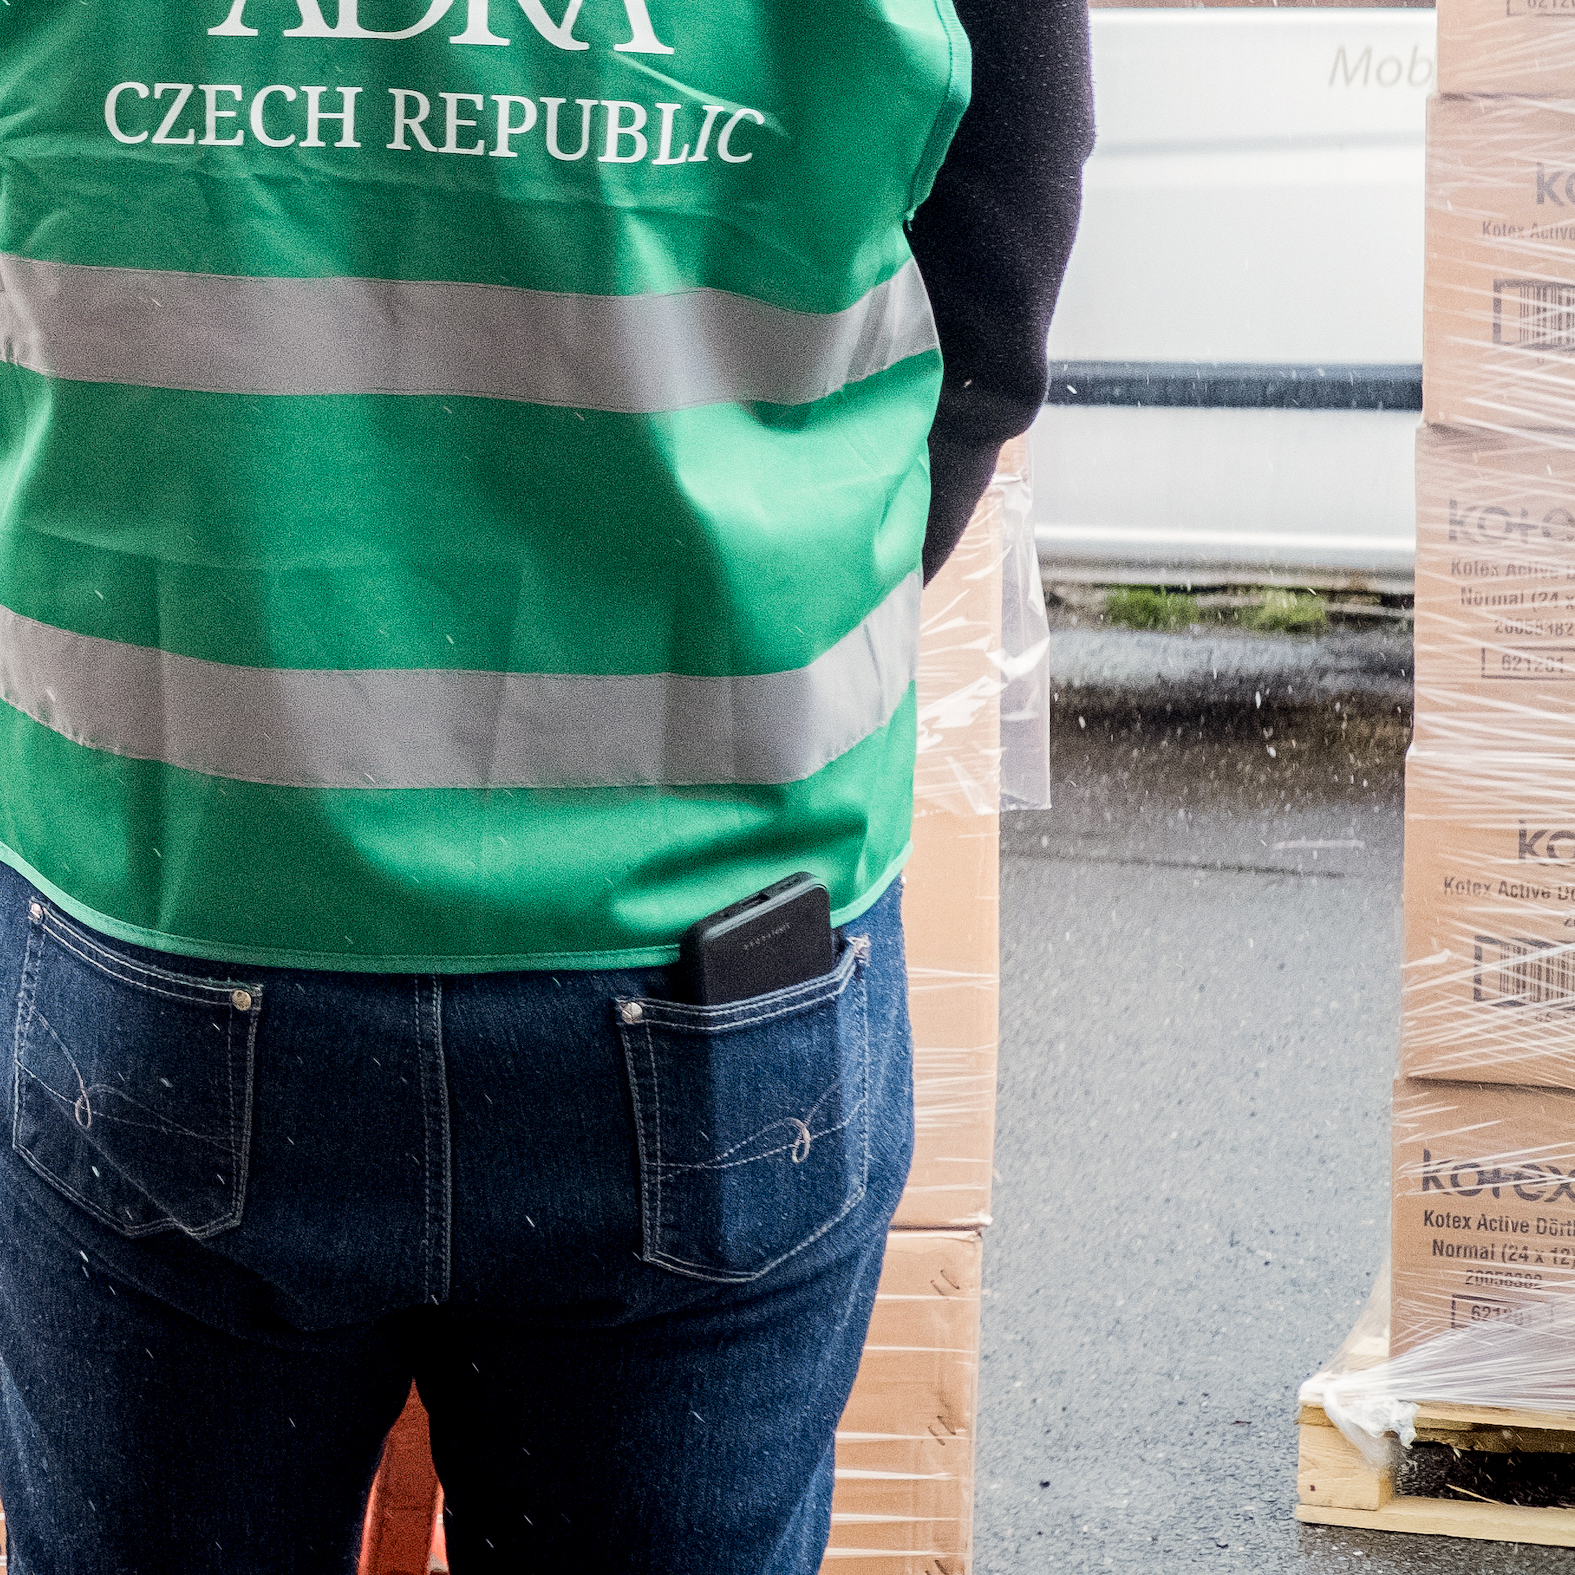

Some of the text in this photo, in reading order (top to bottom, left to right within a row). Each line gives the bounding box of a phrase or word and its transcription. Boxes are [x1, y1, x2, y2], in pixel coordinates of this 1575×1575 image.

[105, 81, 765, 167] CZECH REPUBLIC
[1424, 1210, 1472, 1230] Kotex
[1477, 1213, 1529, 1234] Active
[1432, 1239, 1495, 1261] Normal
